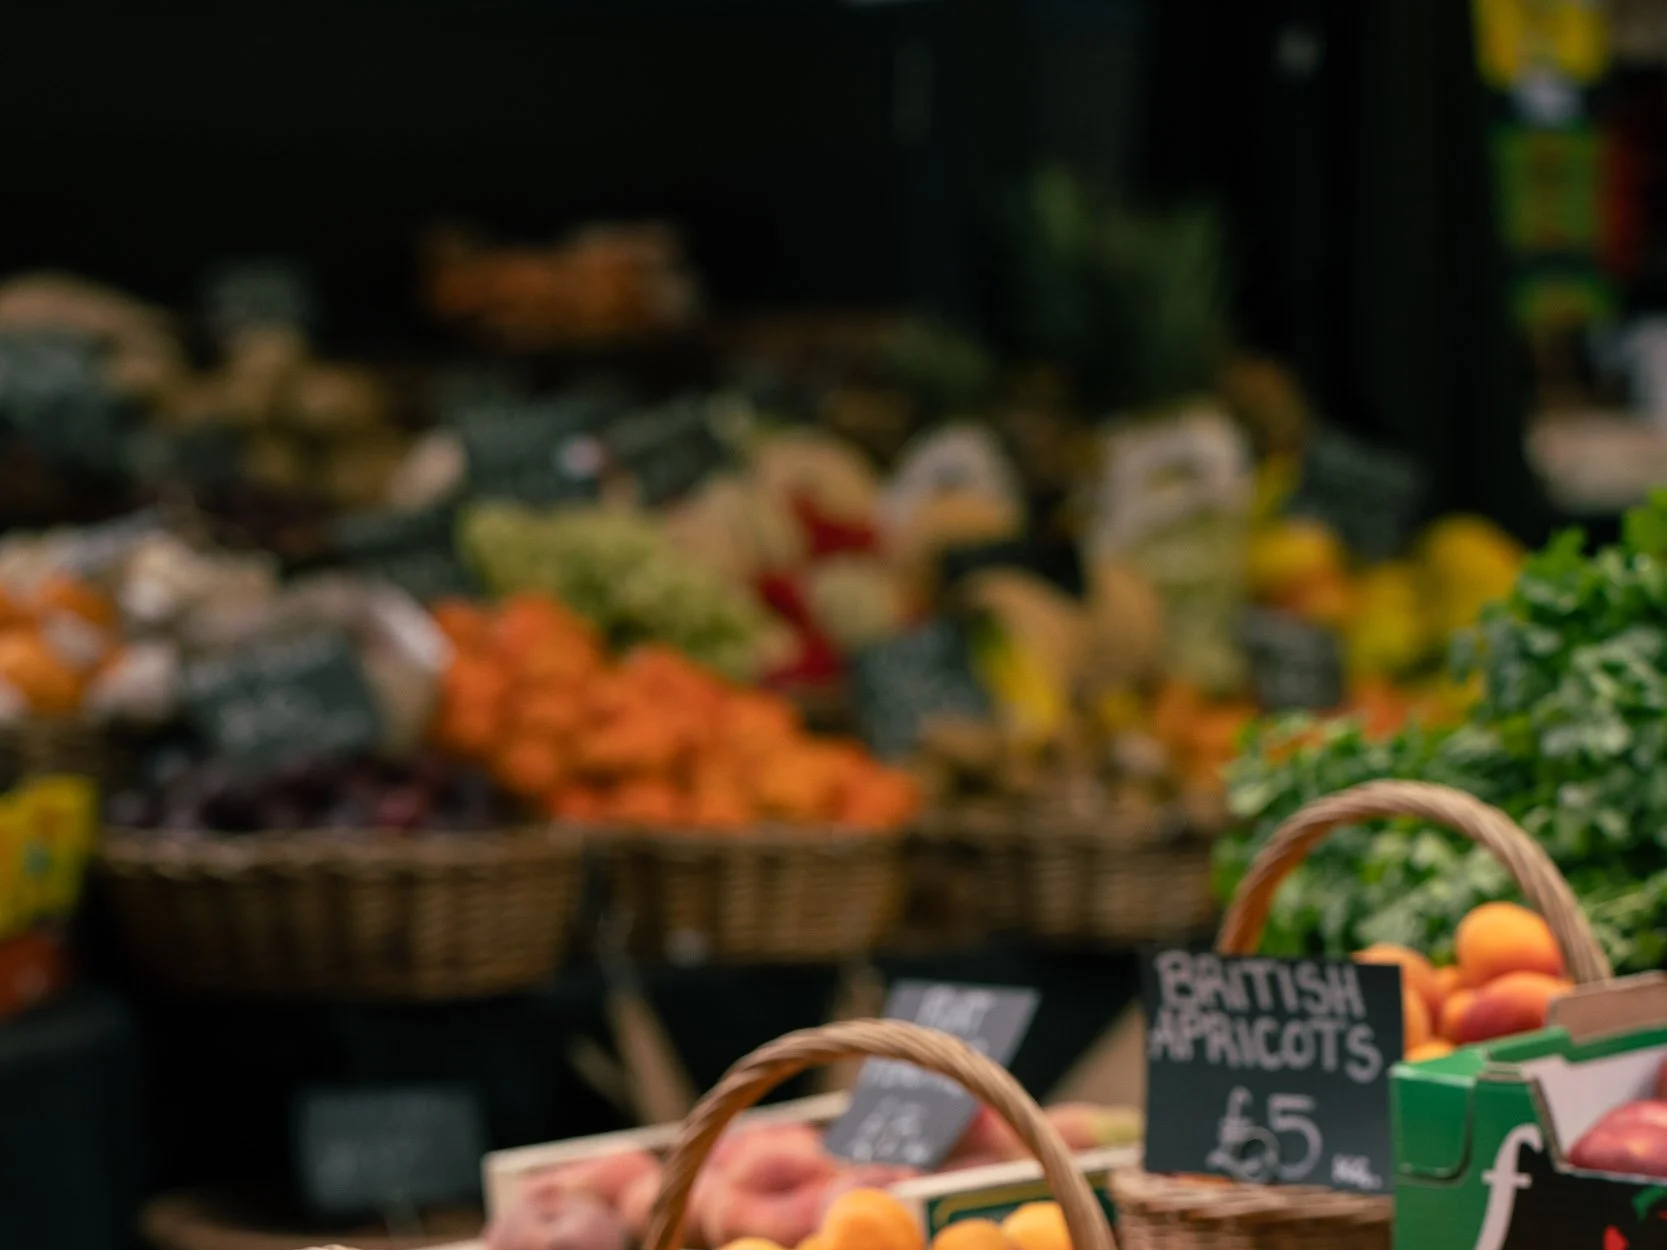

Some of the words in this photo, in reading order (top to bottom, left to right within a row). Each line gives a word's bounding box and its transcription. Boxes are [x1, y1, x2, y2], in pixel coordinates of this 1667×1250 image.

[1155, 951, 1366, 1019] BRITISH
[1148, 1004, 1383, 1083] APRICOTS
[1206, 1086, 1323, 1181] £5
